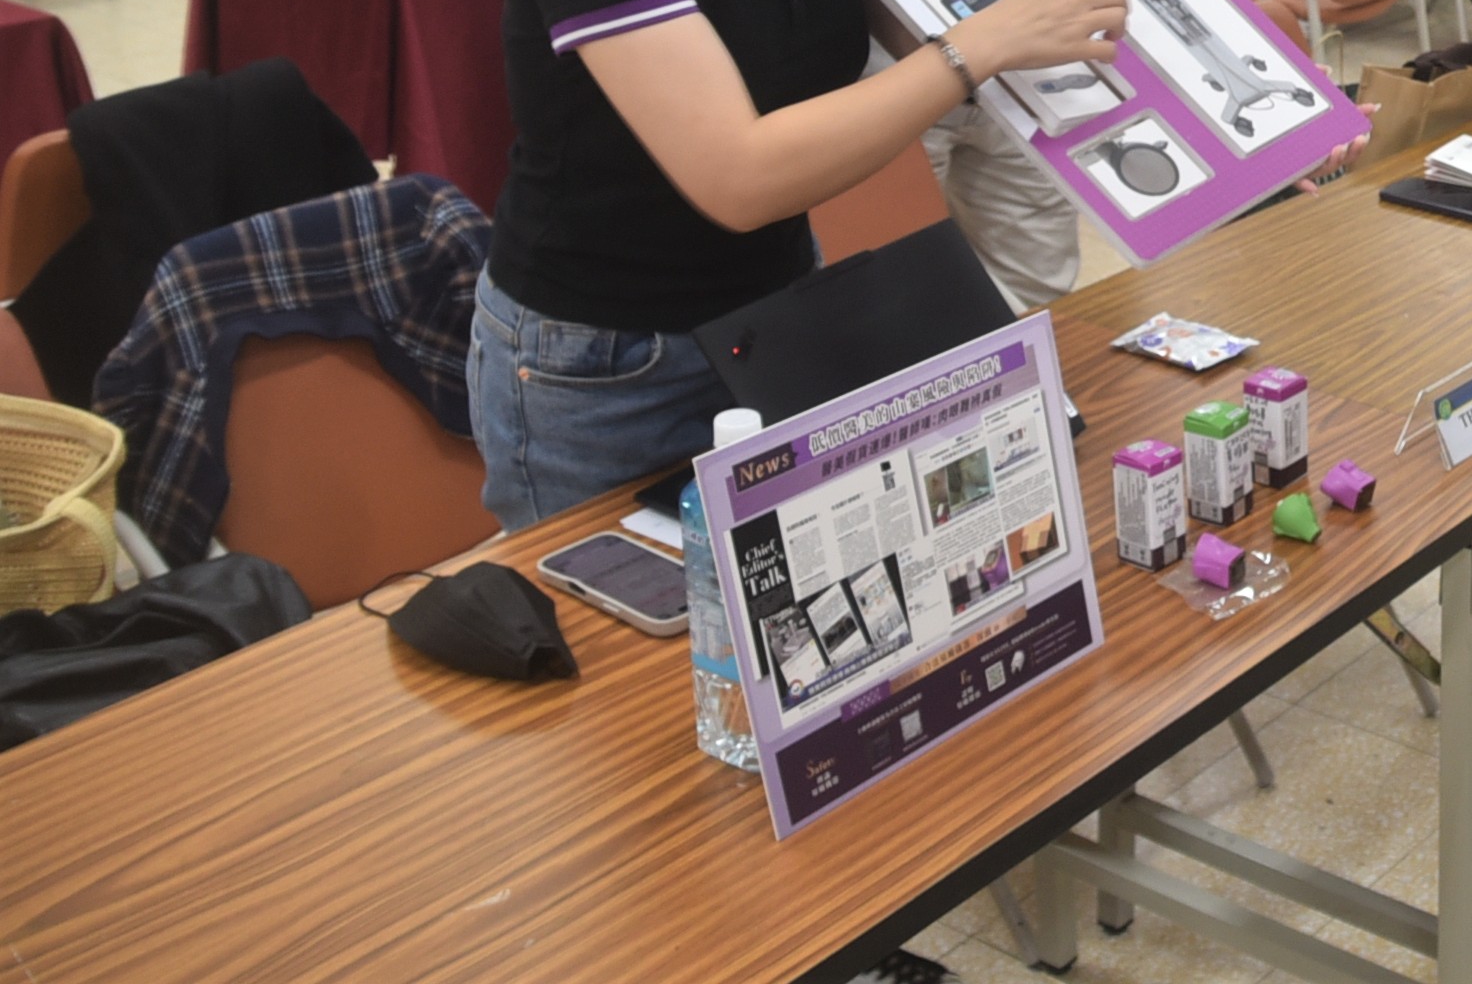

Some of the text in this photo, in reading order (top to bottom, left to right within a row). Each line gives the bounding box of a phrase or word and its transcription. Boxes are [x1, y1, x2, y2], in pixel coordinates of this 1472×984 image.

[739, 450, 791, 486] News
[742, 549, 785, 579] Editor's
[744, 538, 776, 563] Chief
[745, 565, 787, 597] Talk
